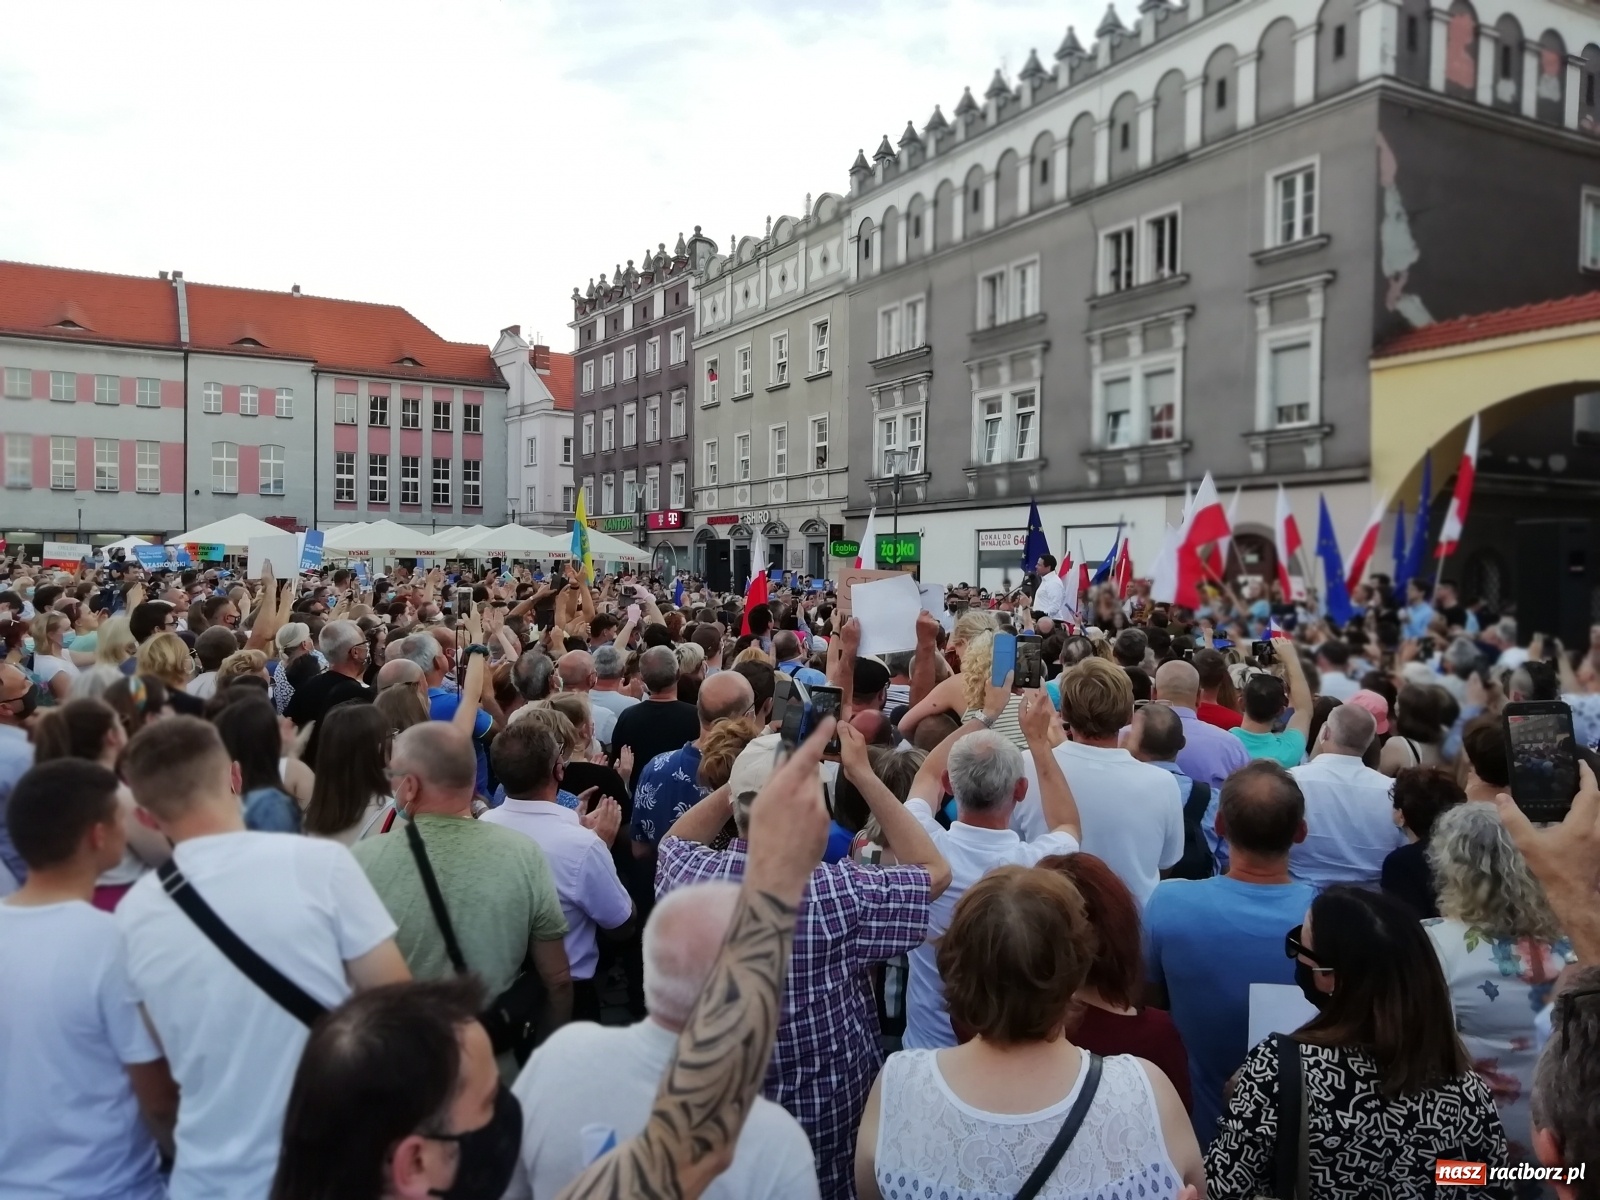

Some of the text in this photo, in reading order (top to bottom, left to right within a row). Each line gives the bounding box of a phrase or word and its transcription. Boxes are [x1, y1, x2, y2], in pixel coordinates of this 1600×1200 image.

[604, 518, 633, 531] KANTOR
[668, 512, 678, 525] T
[835, 543, 858, 552] żabka
